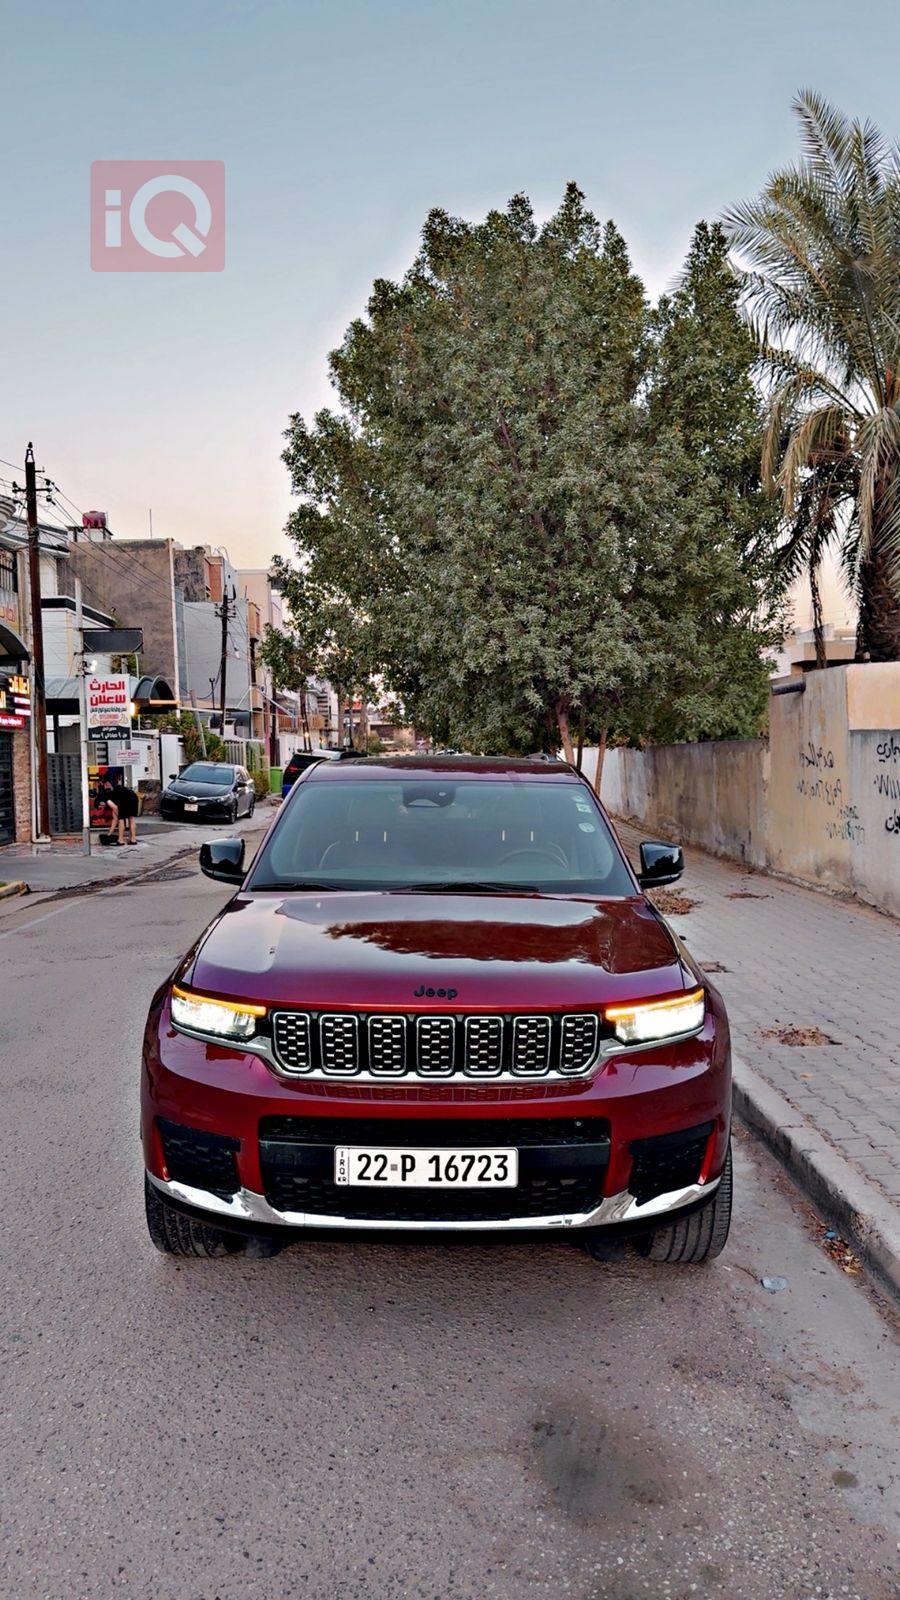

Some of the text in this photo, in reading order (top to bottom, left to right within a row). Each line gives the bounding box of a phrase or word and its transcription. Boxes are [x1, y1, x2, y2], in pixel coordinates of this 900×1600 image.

[90, 678, 125, 693] الحارث
[413, 985, 458, 1000] Jeep
[357, 1153, 508, 1183] 22 P 16723
